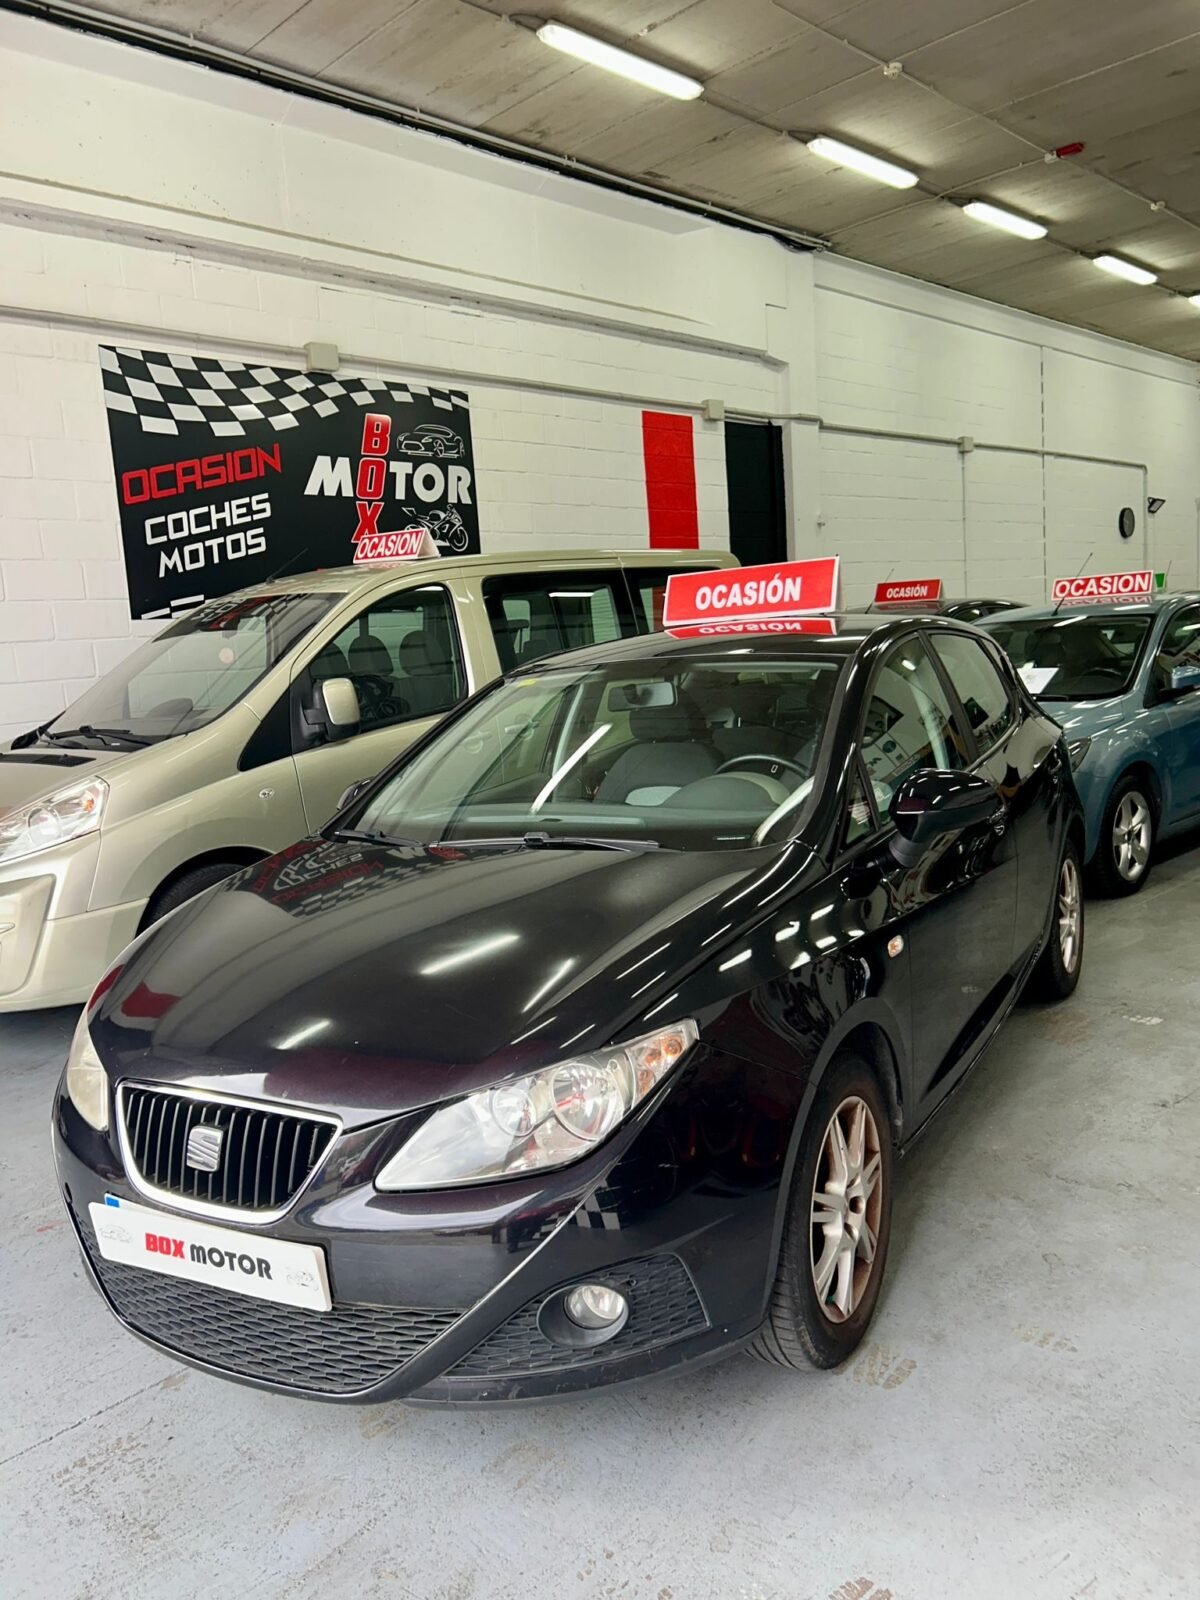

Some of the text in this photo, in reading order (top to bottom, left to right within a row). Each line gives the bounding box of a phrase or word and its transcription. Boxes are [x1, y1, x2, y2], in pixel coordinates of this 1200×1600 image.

[122, 443, 282, 505] OCASION
[304, 455, 472, 505] MOTOR
[351, 413, 392, 543] BOX
[144, 492, 271, 545] COCHES
[158, 527, 267, 578] MOTOS
[358, 530, 423, 558] OCASION
[695, 573, 802, 610] OCASIÓN
[886, 584, 928, 599] OCASIÓN
[1055, 573, 1149, 598] OCASION
[145, 1232, 273, 1280] BOX MOTOR
